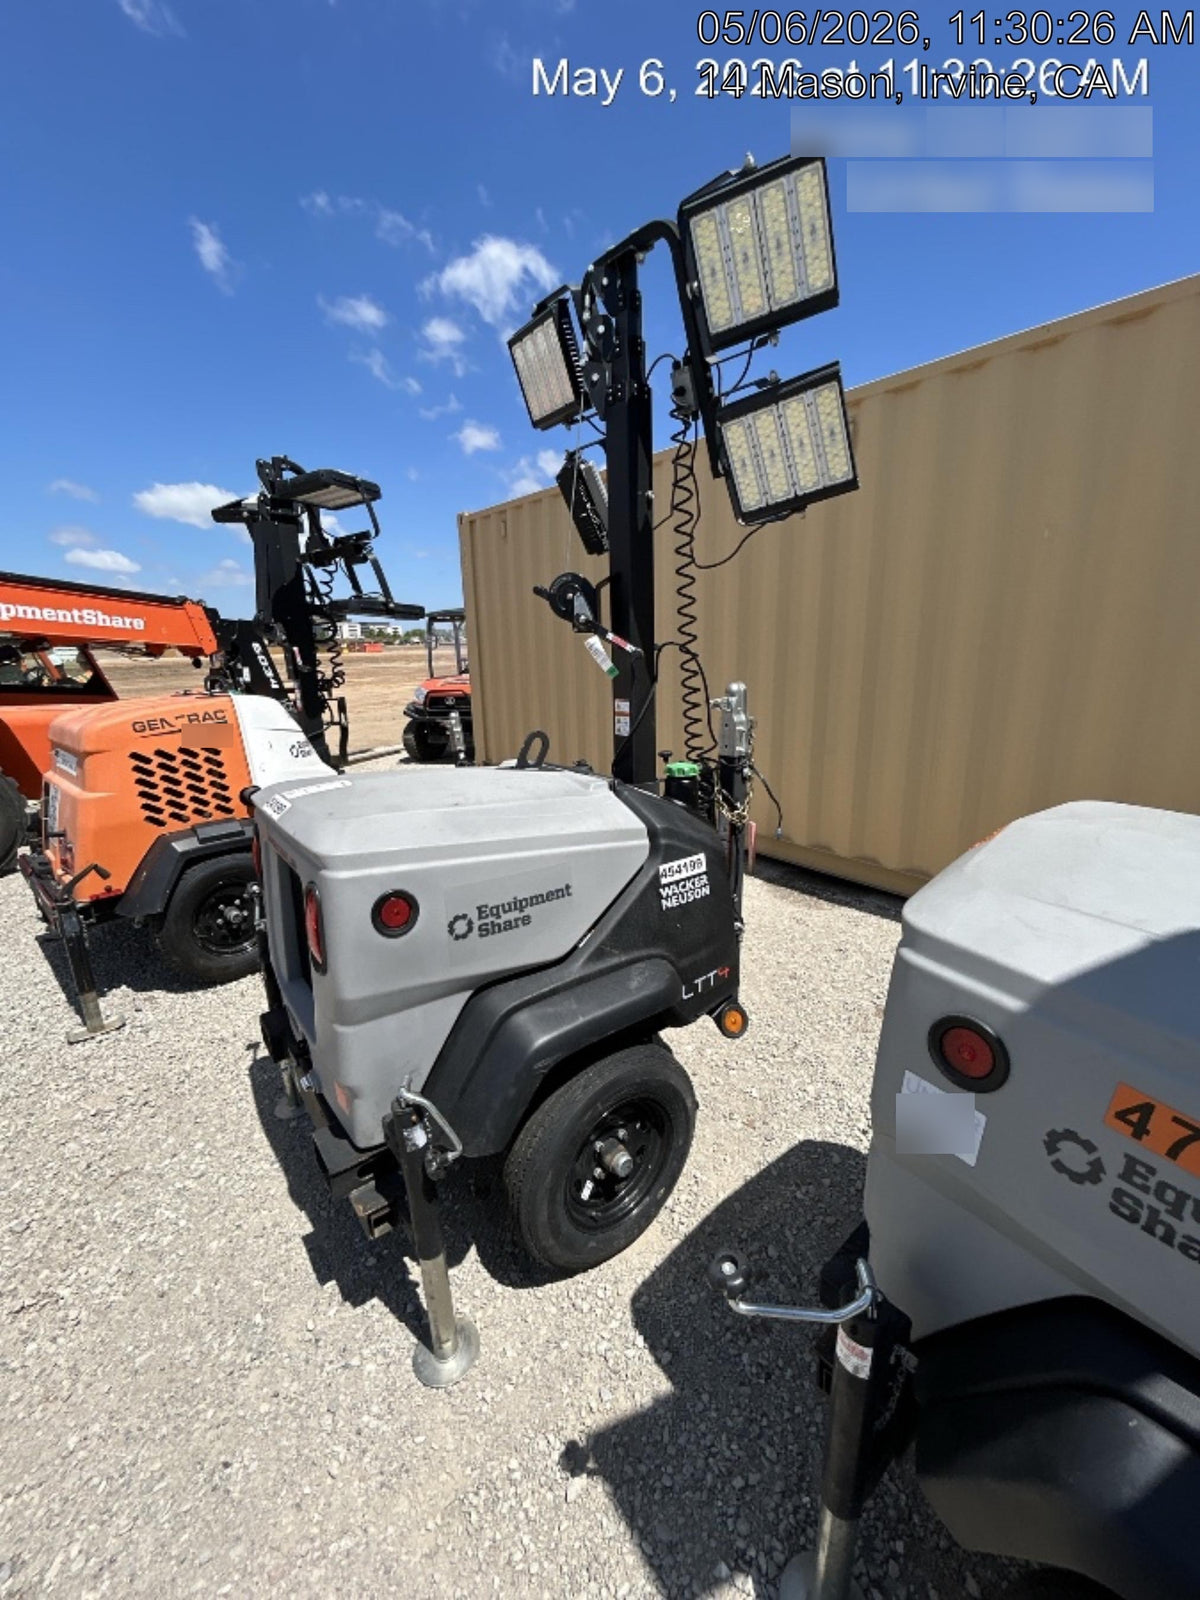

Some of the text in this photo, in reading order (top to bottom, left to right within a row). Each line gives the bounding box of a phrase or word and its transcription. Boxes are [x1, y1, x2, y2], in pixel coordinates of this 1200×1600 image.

[0, 603, 146, 630] pmentShare
[132, 709, 228, 733] GENRAC
[659, 874, 709, 898] WACKER
[661, 885, 711, 911] NEUSON
[476, 883, 572, 920] Equipment
[478, 914, 532, 938] Share
